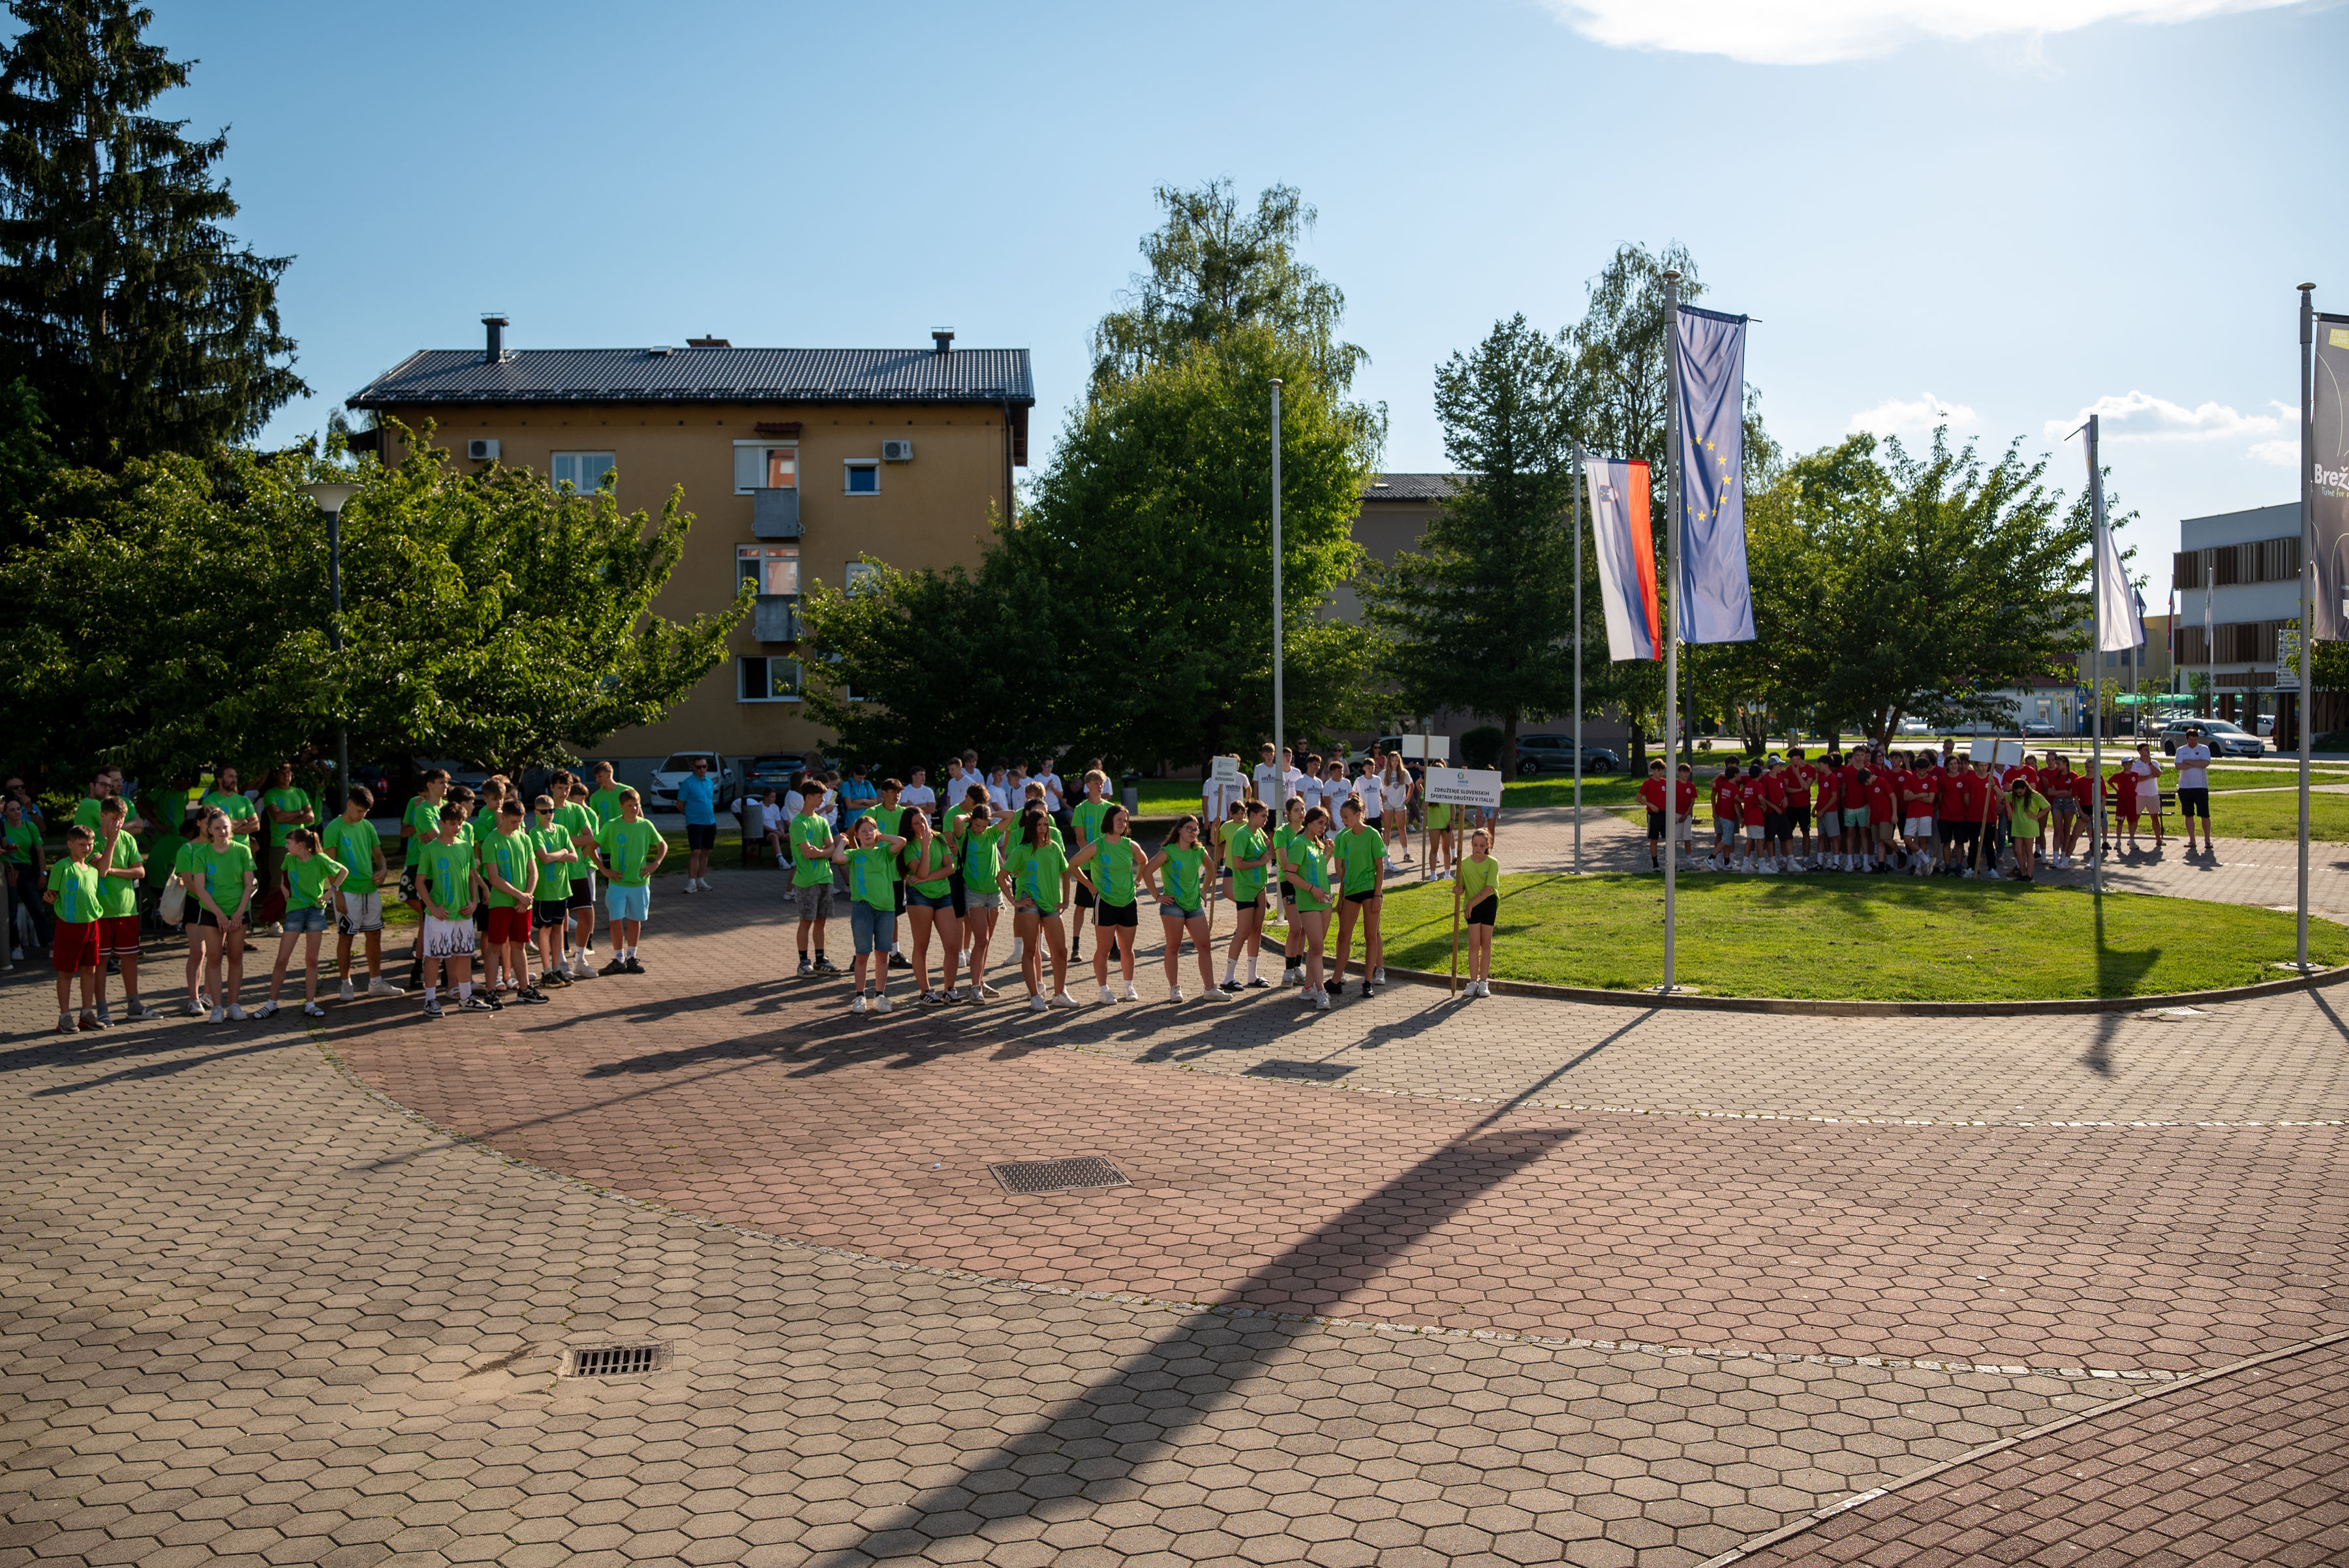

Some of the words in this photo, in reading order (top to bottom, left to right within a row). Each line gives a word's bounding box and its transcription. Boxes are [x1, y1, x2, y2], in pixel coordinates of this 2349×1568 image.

[2314, 463, 2349, 491] Brež
[2322, 486, 2335, 497] Time
[2336, 487, 2345, 498] for
